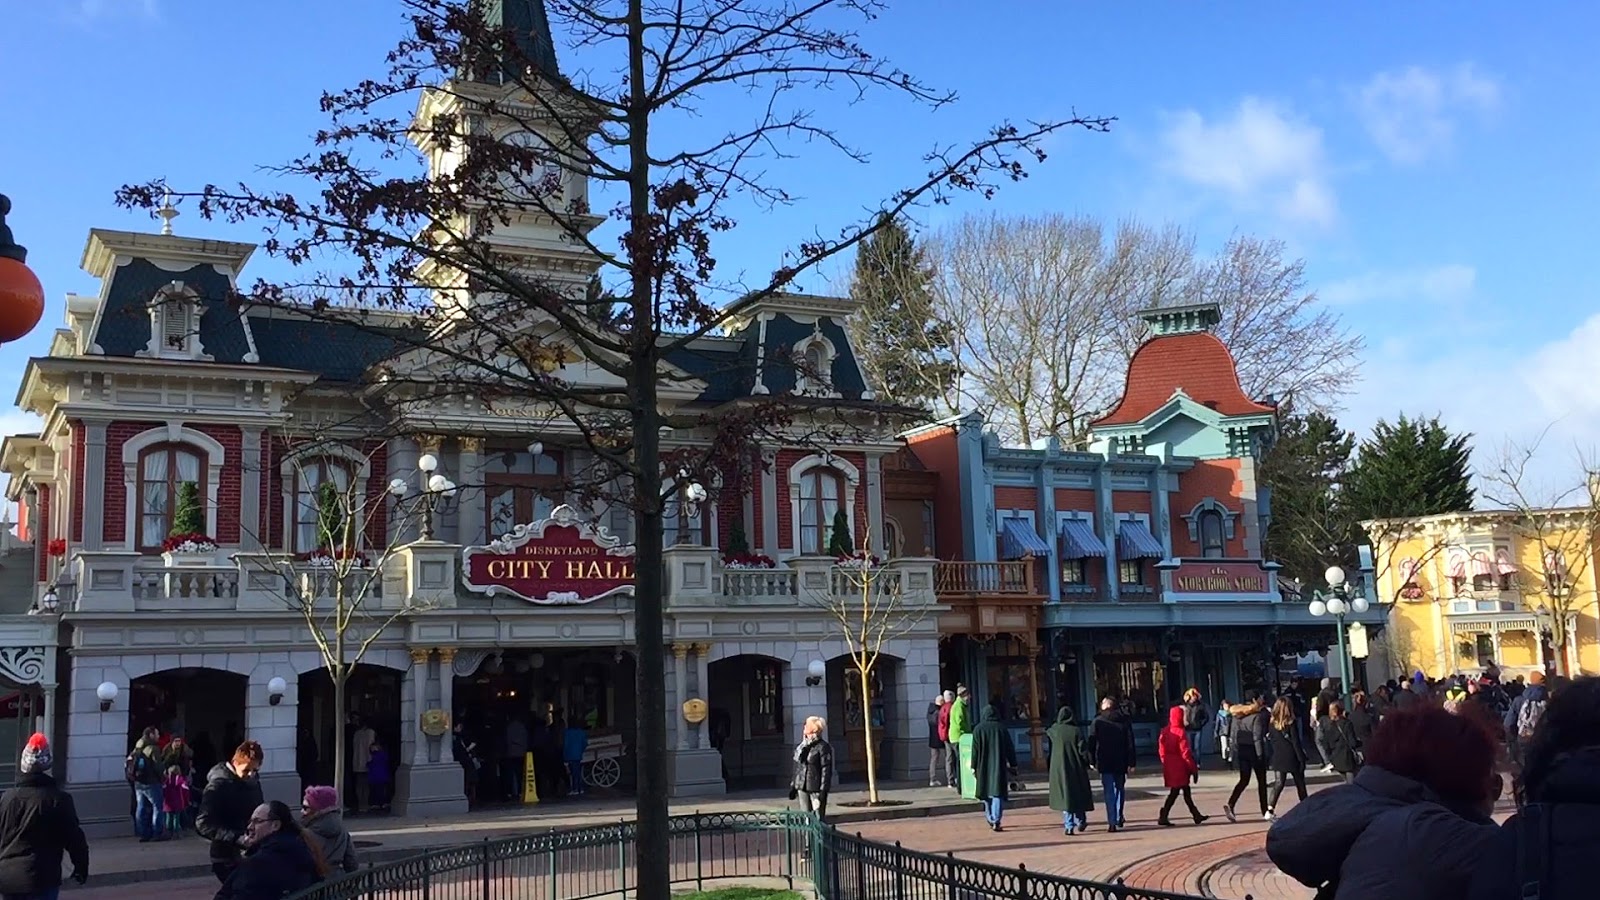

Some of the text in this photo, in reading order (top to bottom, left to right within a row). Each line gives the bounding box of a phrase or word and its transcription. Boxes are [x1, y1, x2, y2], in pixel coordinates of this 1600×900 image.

[525, 546, 598, 556] DISNEYLAND
[487, 559, 635, 579] CITY HALL
[1178, 576, 1263, 590] STORYBOOK STORE
